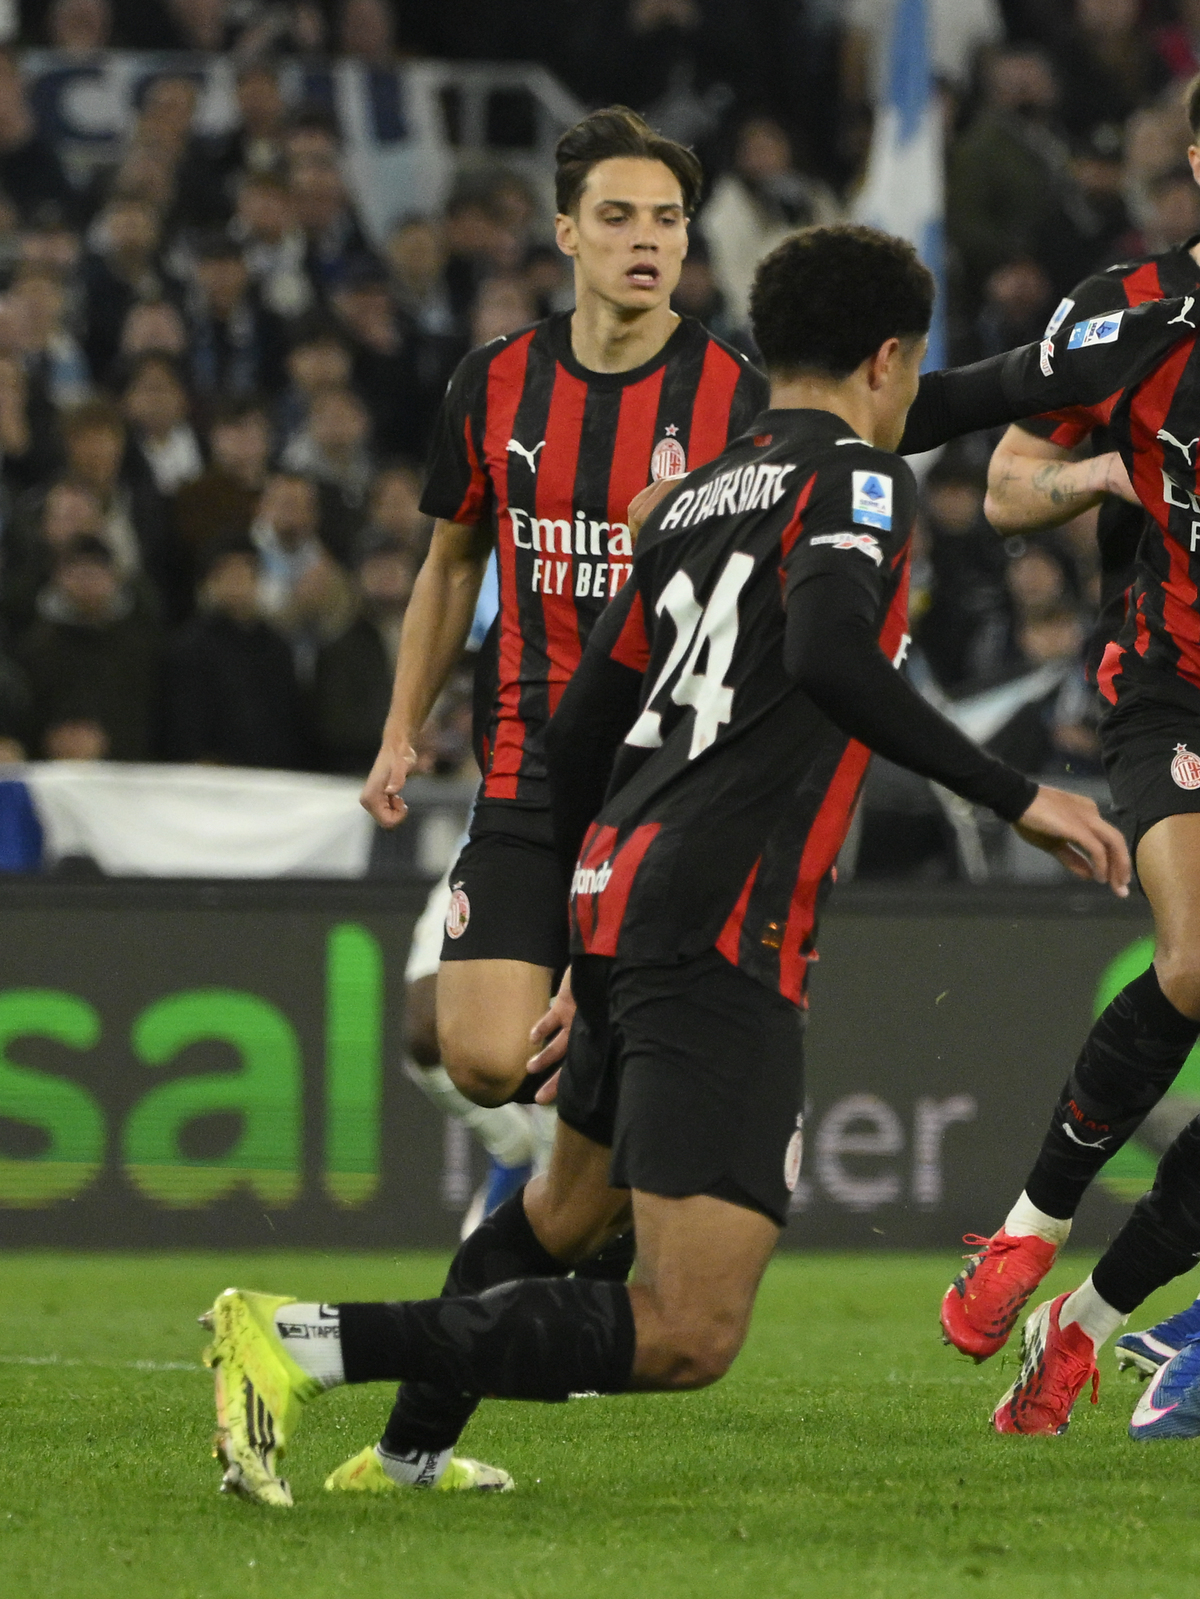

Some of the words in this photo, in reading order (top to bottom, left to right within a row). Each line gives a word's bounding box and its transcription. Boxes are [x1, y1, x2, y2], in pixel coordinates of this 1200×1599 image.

[506, 507, 634, 556] Emira
[531, 558, 568, 595] FLY
[624, 551, 755, 761] 24
